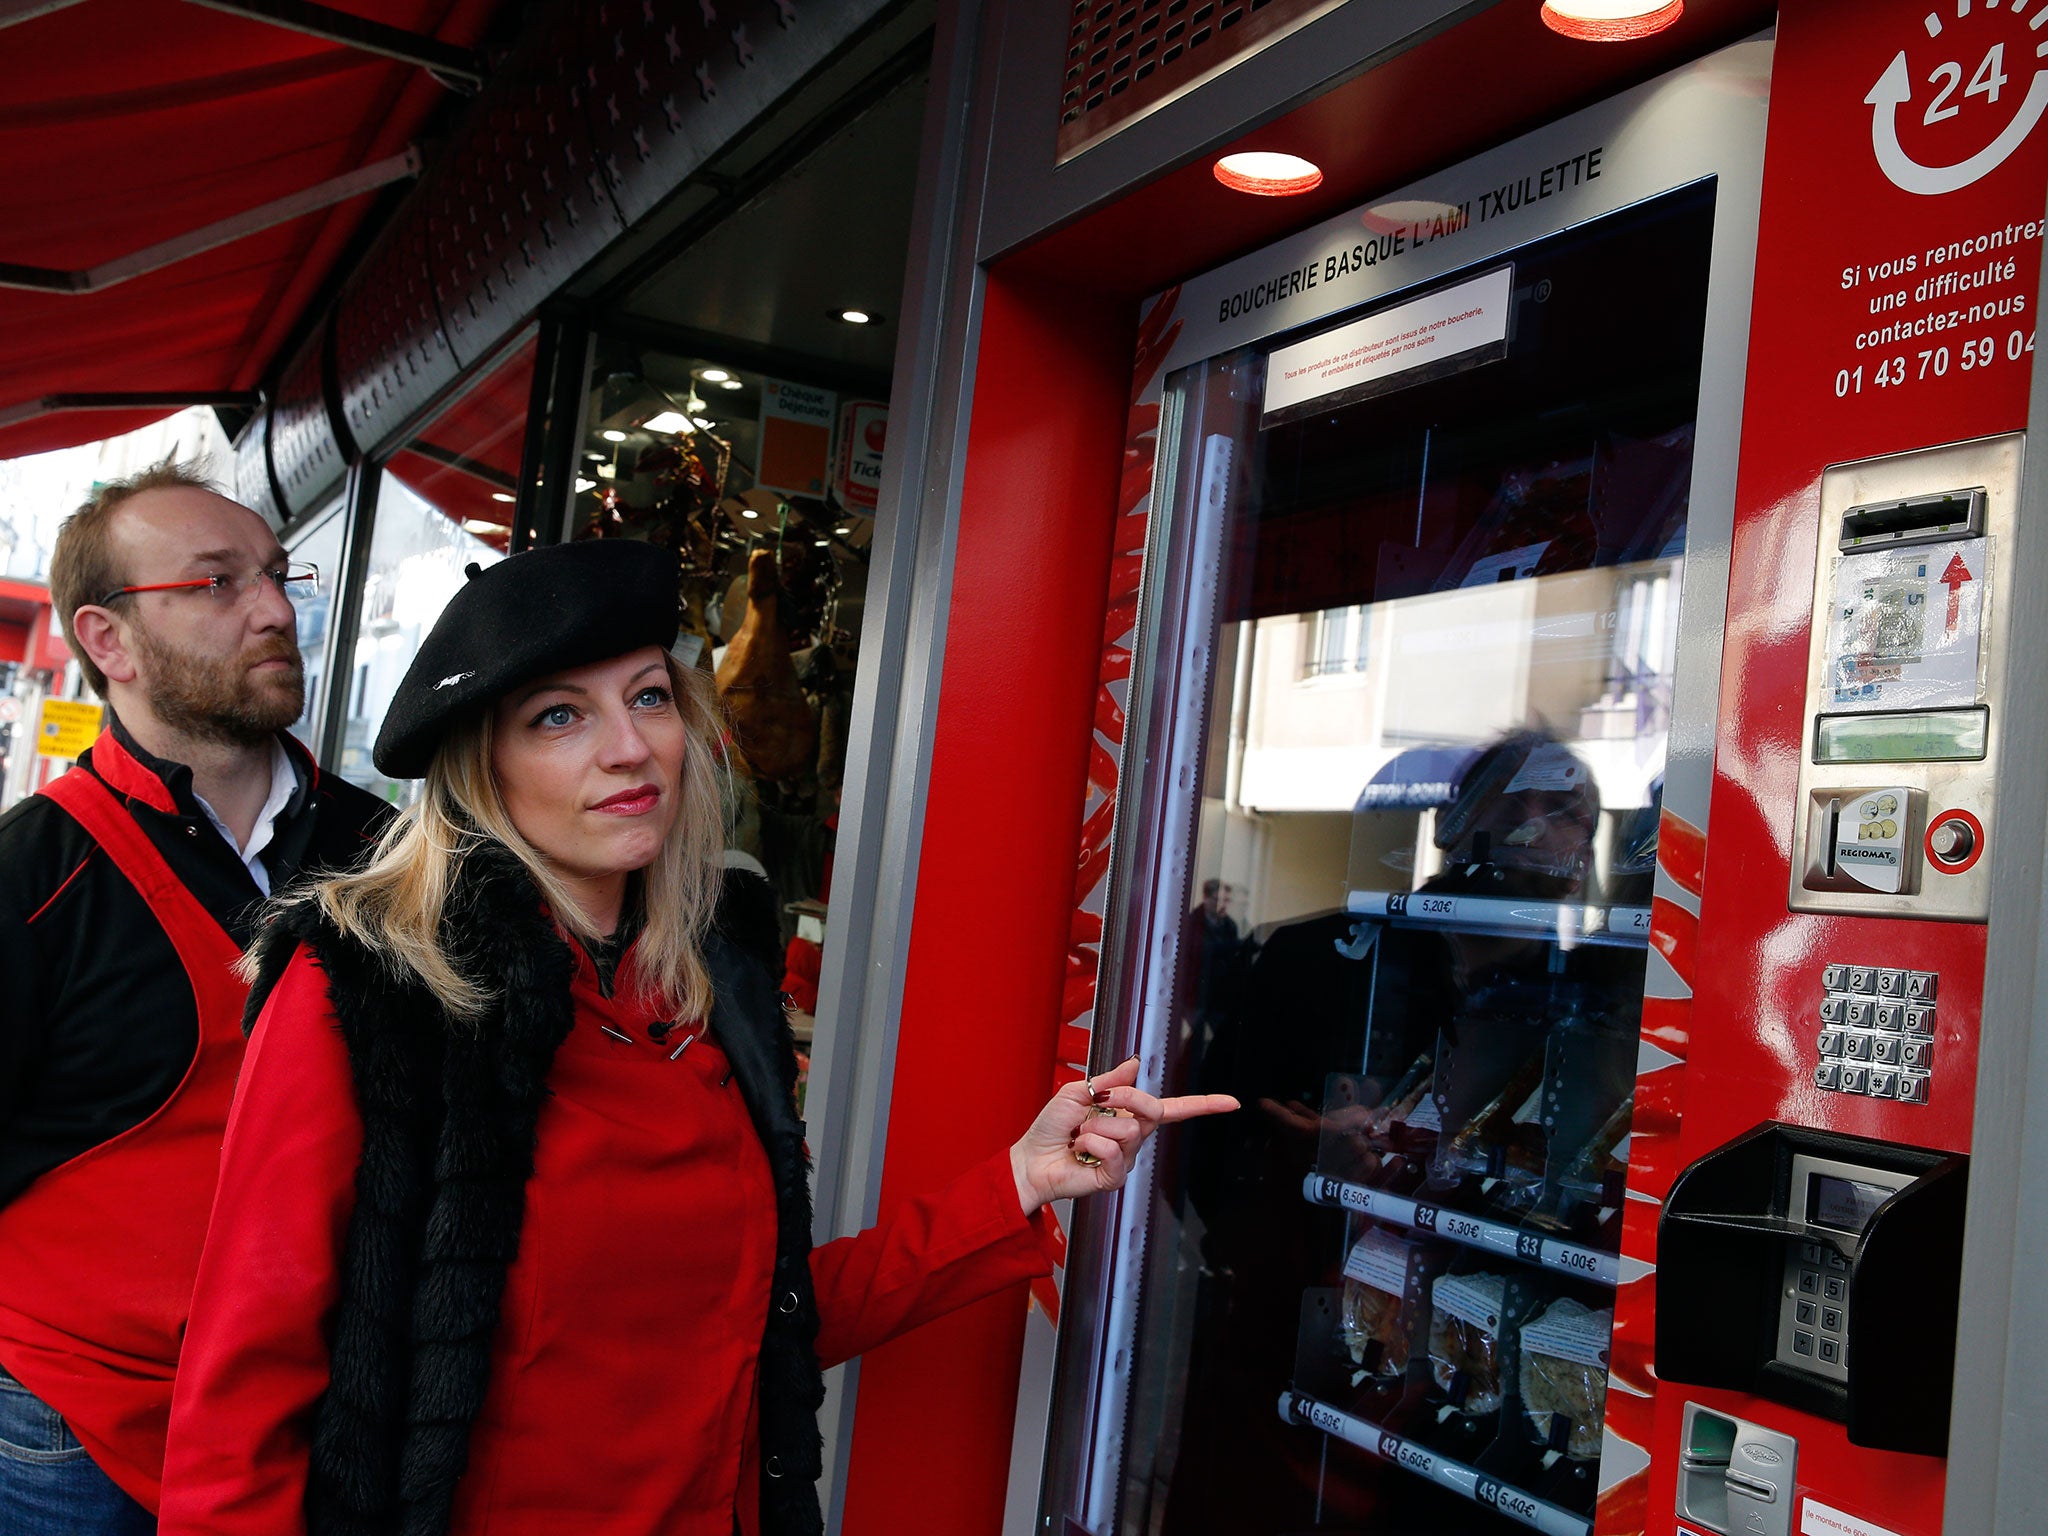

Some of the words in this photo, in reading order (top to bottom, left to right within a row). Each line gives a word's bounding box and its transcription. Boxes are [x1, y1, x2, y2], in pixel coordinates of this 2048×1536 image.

[1923, 42, 2008, 126] 24
[1219, 262, 1319, 323] BOUCHERIE
[1324, 227, 1406, 283] BASQUE
[1413, 201, 1471, 249] L'AMI
[1478, 147, 1603, 223] TXULETTE
[1840, 264, 1860, 289] Si
[1867, 254, 1917, 282] vous
[1869, 290, 1907, 315] une
[1915, 256, 2016, 303] difficulté
[1855, 294, 2026, 350] contactez-nous
[1284, 371, 1298, 380] Tous
[1307, 359, 1331, 374] produits
[1332, 356, 1340, 364] de
[1349, 341, 1385, 358] distributeur
[1385, 334, 1400, 346] sont
[1400, 329, 1417, 340] issus
[1419, 326, 1427, 335] de
[1428, 319, 1446, 331] notre
[1447, 307, 1484, 325] boucherie,
[1321, 370, 1328, 378] et
[1328, 361, 1354, 375] emballés
[1355, 359, 1362, 367] et
[1362, 350, 1390, 364] étiquetés
[1391, 345, 1402, 356] par
[1403, 341, 1416, 351] nos
[1416, 335, 1435, 347] soins
[1834, 365, 1863, 398] 01
[1874, 356, 1906, 388] 43
[1917, 346, 1949, 380] 70
[1960, 336, 1995, 371] 59
[780, 385, 825, 404] Chèque
[1390, 894, 1405, 910] 21
[1422, 899, 1452, 913] 5,20€
[1827, 972, 1833, 985] 1
[1852, 974, 1862, 987] 2
[1881, 976, 1890, 990] 3
[1909, 980, 1920, 993] A
[1823, 1004, 1832, 1017] 4
[1850, 1007, 1859, 1020] 5
[1879, 1010, 1888, 1023] 6
[1907, 1013, 1917, 1027] B
[1821, 1036, 1830, 1049] 7
[1847, 1040, 1857, 1053] 8
[1876, 1043, 1885, 1057] 9
[1904, 1047, 1914, 1060] C
[1844, 1072, 1854, 1085] 0
[1901, 1082, 1911, 1094] D
[1325, 1180, 1340, 1198] 31
[1342, 1189, 1370, 1207] 8,50€
[1418, 1207, 1434, 1226] 32
[1447, 1218, 1480, 1239] 5,30€
[1521, 1236, 1538, 1256] 33
[1560, 1250, 1597, 1272] 5,00€
[1808, 1245, 1815, 1259] 1
[1803, 1275, 1813, 1289] 4
[1829, 1282, 1838, 1295] 5
[1802, 1305, 1810, 1319] 7
[1826, 1312, 1836, 1327] 8
[1823, 1343, 1833, 1357] 0
[1297, 1399, 1310, 1419] 41
[1313, 1408, 1341, 1430] 6,30€
[1381, 1436, 1398, 1456] 42
[1400, 1448, 1432, 1471] 5,60€
[1478, 1482, 1496, 1504] 43
[1500, 1492, 1536, 1518] 5,40€
[1815, 1515, 1842, 1530] montant
[1843, 1525, 1852, 1535] de
